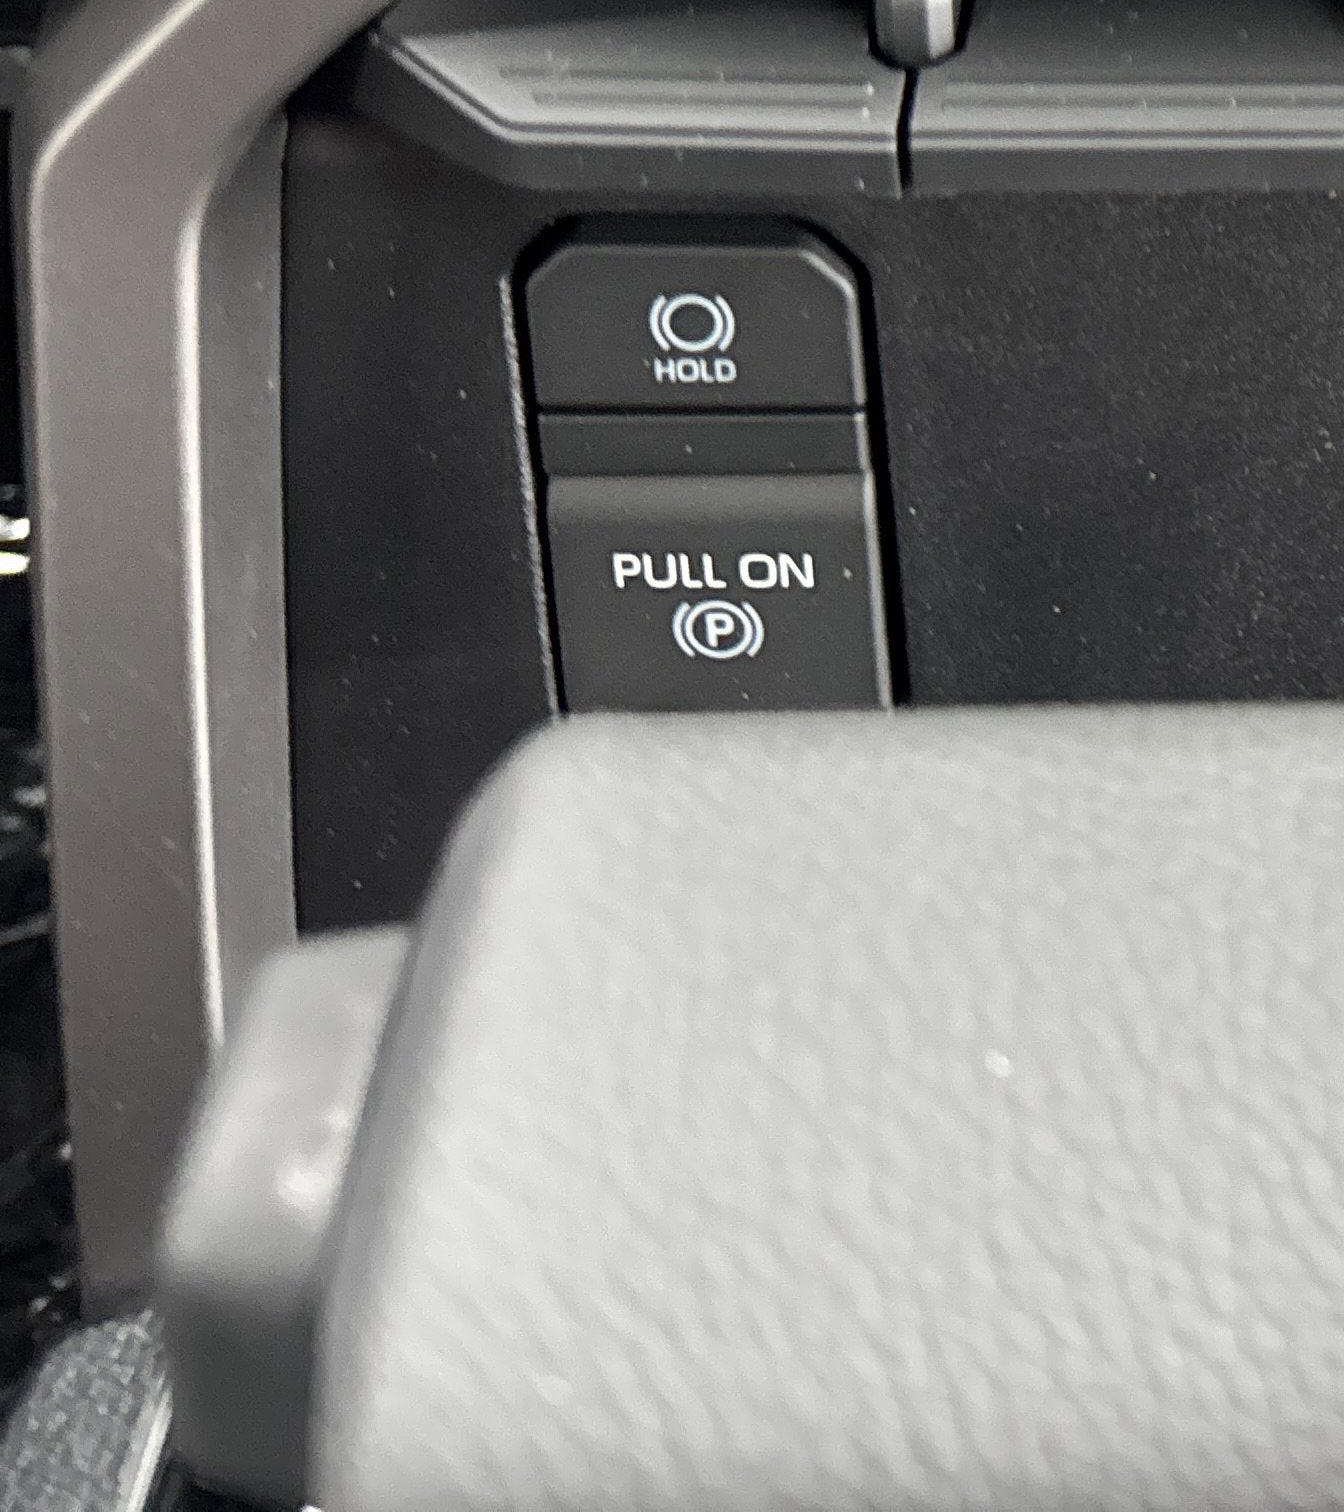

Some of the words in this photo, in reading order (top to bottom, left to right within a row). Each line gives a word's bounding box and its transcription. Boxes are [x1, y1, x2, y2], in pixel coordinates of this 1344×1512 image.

[654, 357, 737, 384] HOLD
[611, 552, 728, 589] PULL
[738, 552, 815, 589] ON
[705, 612, 734, 647] P
